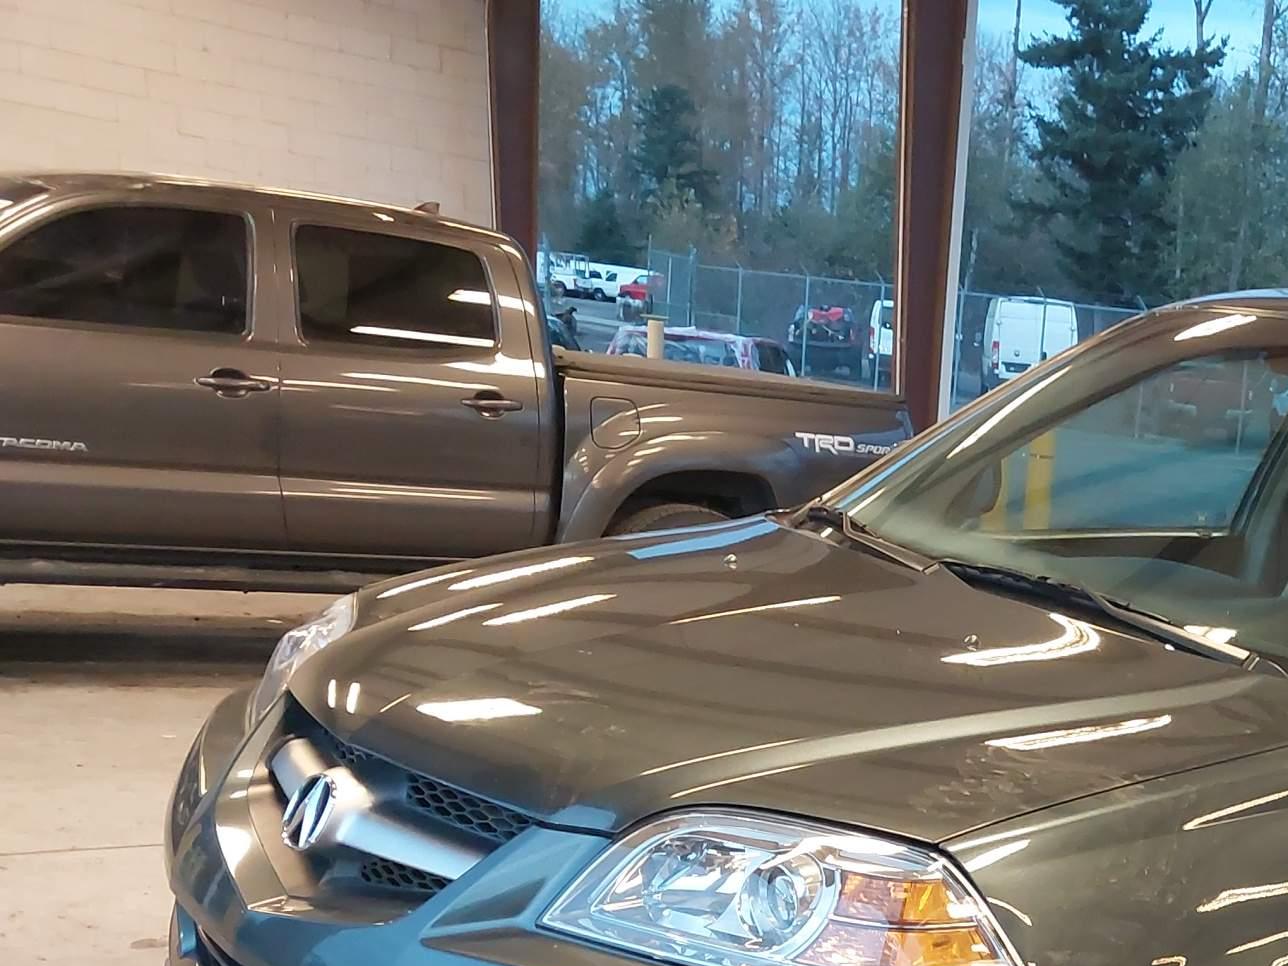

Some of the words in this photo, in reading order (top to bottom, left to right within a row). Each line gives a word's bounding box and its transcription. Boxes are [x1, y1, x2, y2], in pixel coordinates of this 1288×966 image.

[0, 436, 88, 452] ACOMA
[795, 432, 855, 456] TRD
[856, 443, 897, 455] SPOR
